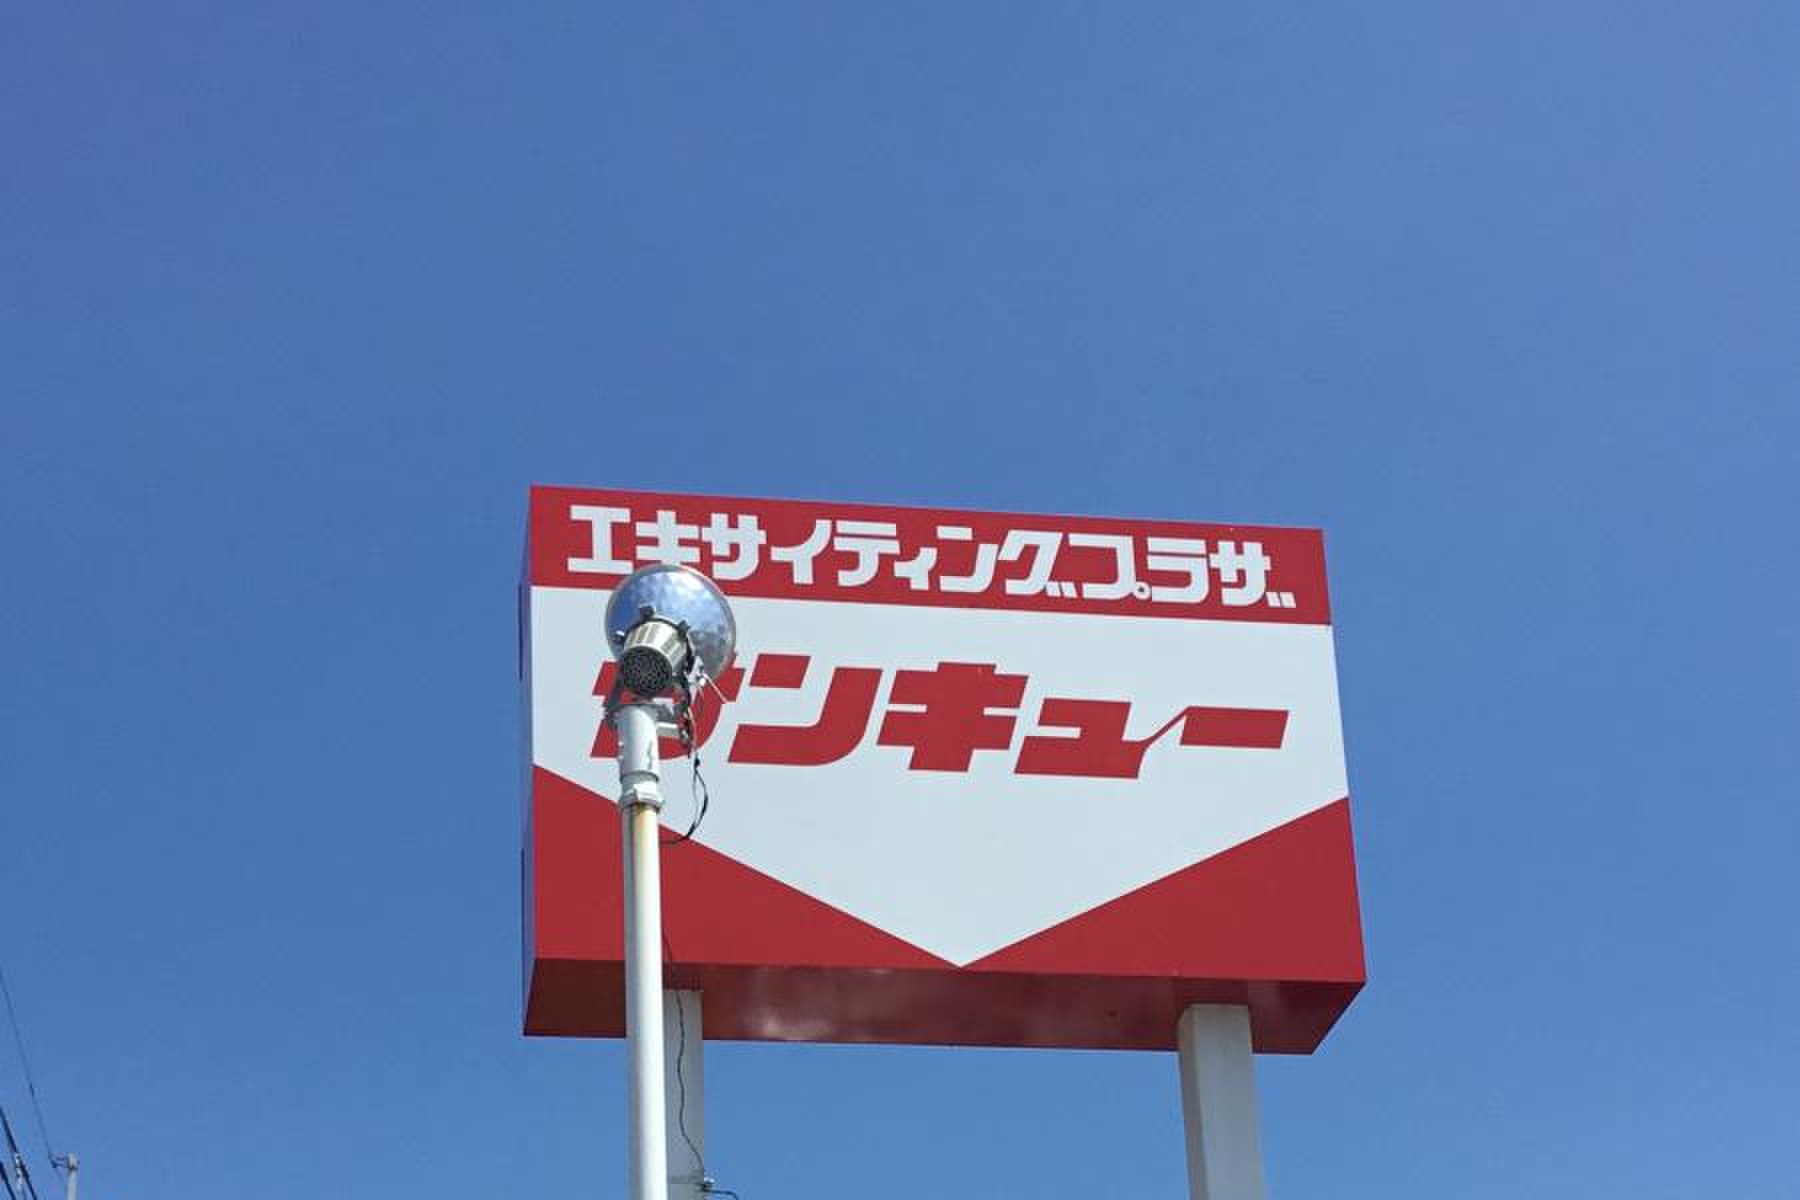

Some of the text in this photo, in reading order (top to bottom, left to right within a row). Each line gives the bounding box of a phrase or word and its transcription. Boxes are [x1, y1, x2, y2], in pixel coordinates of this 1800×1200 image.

[567, 505, 1297, 609] エキサイティングプラザ
